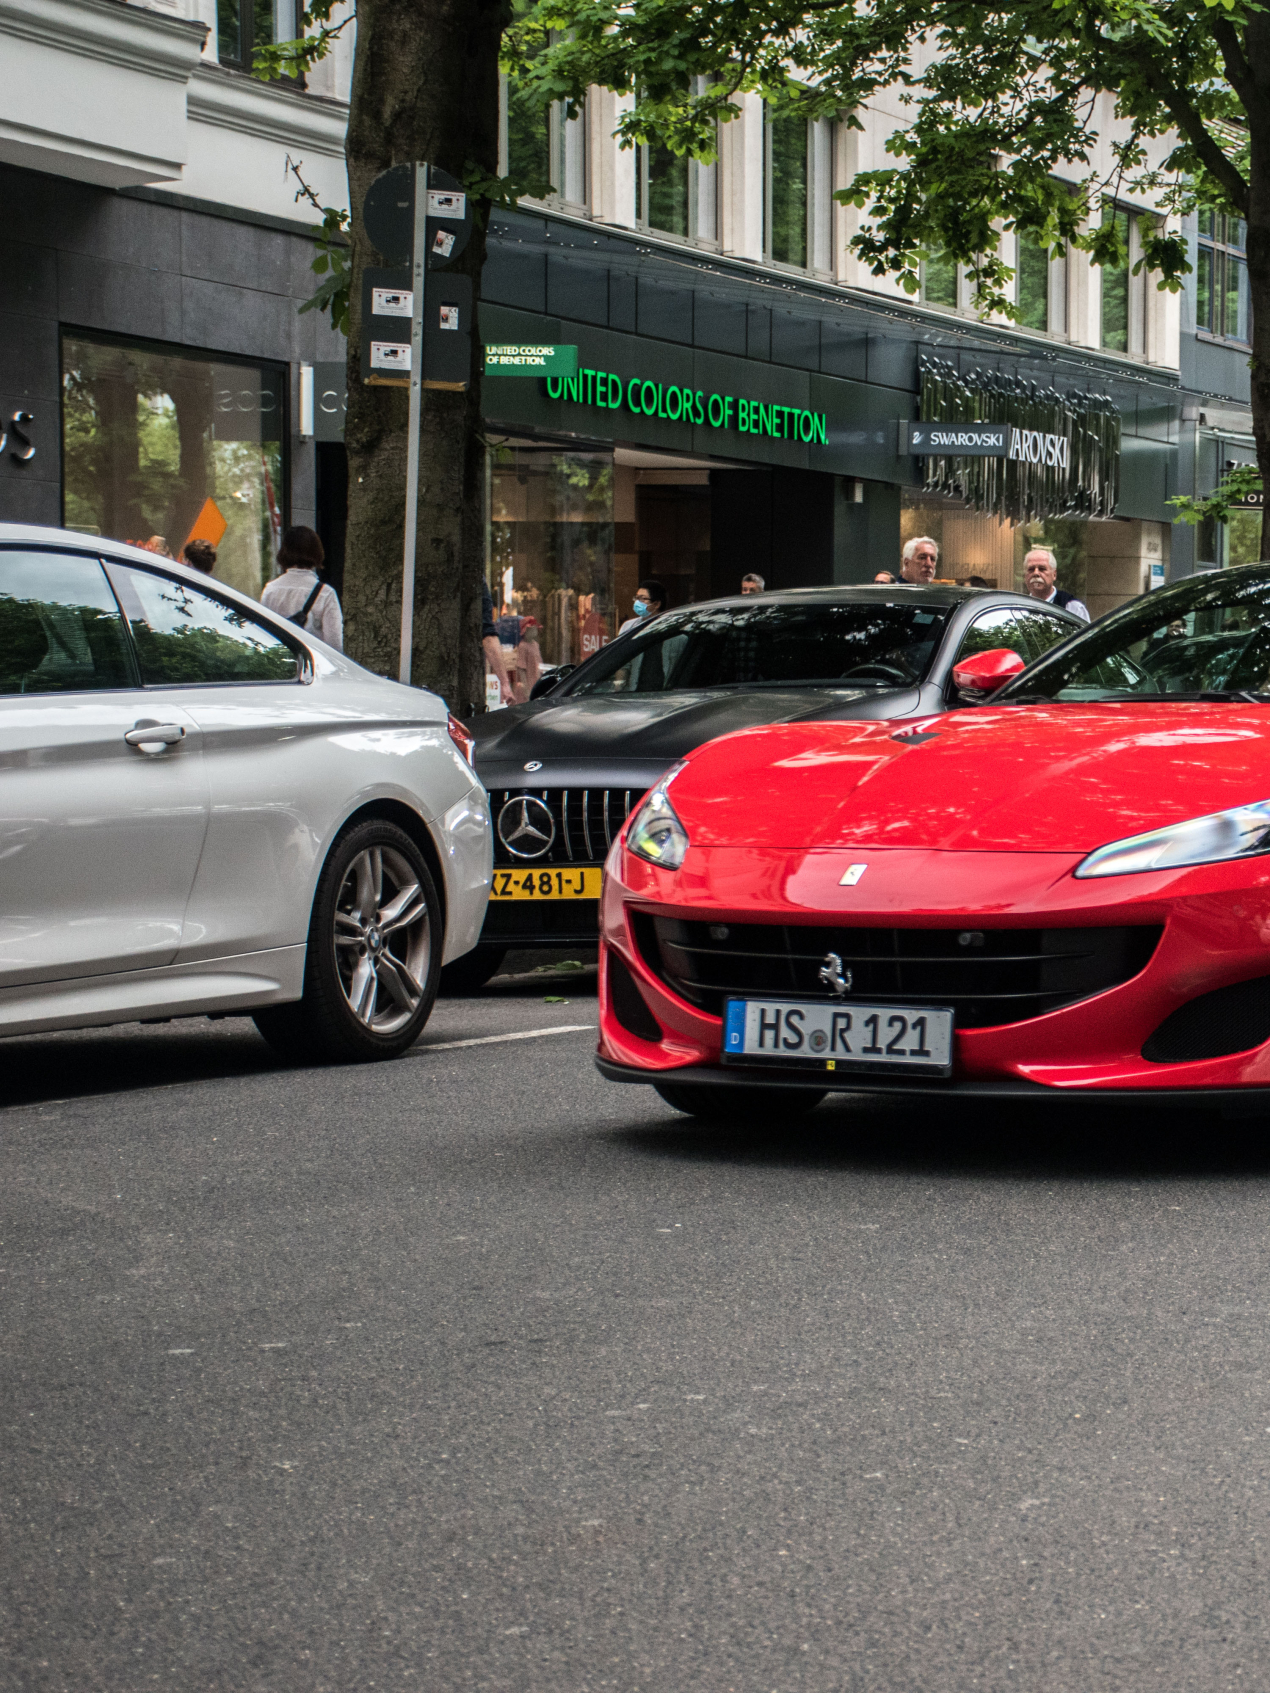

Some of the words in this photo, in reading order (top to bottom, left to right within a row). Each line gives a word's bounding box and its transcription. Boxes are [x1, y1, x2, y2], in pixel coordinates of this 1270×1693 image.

[486, 346, 518, 355] UNITED
[519, 347, 555, 356] COLORS
[486, 356, 499, 364] OF
[500, 356, 546, 366] BENETTON.
[320, 391, 348, 412] C
[547, 367, 623, 409] UNITED
[627, 378, 704, 424] COLORS
[708, 393, 733, 429] OF
[738, 398, 829, 445] BENETTON.
[0, 410, 36, 460] S
[930, 432, 1003, 447] SWAROVSKI
[1010, 427, 1068, 468] AROVSKI
[730, 1032, 740, 1044] D
[758, 1007, 806, 1050] HS
[830, 1011, 853, 1052] R
[862, 1013, 931, 1057] 121
